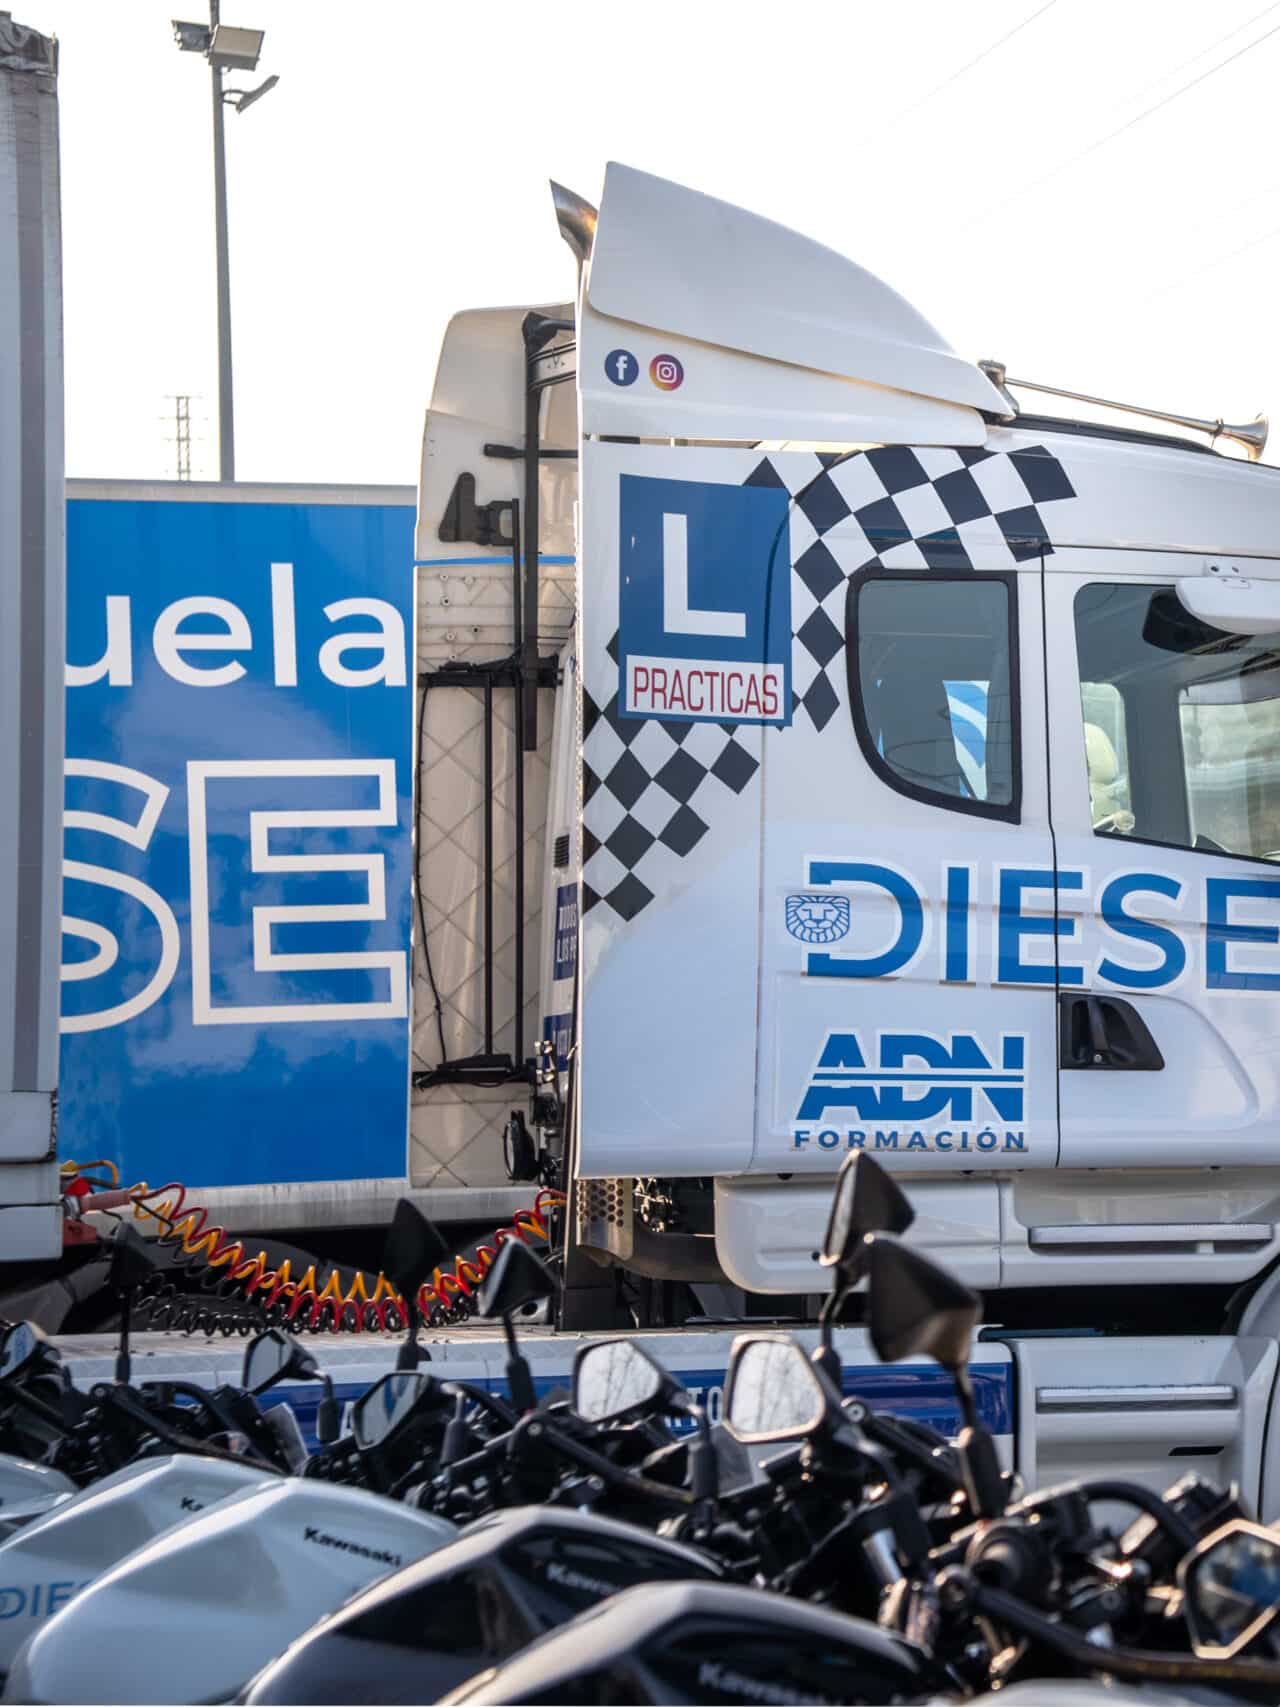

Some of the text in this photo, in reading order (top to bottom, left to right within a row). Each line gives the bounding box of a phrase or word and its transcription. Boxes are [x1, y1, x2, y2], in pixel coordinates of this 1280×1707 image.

[663, 513, 746, 637] L
[633, 666, 778, 715] PRACTICAS
[796, 1033, 1025, 1121] ADN
[794, 1127, 1025, 1150] FORMACIÓN
[303, 1526, 402, 1567] Kawasaki
